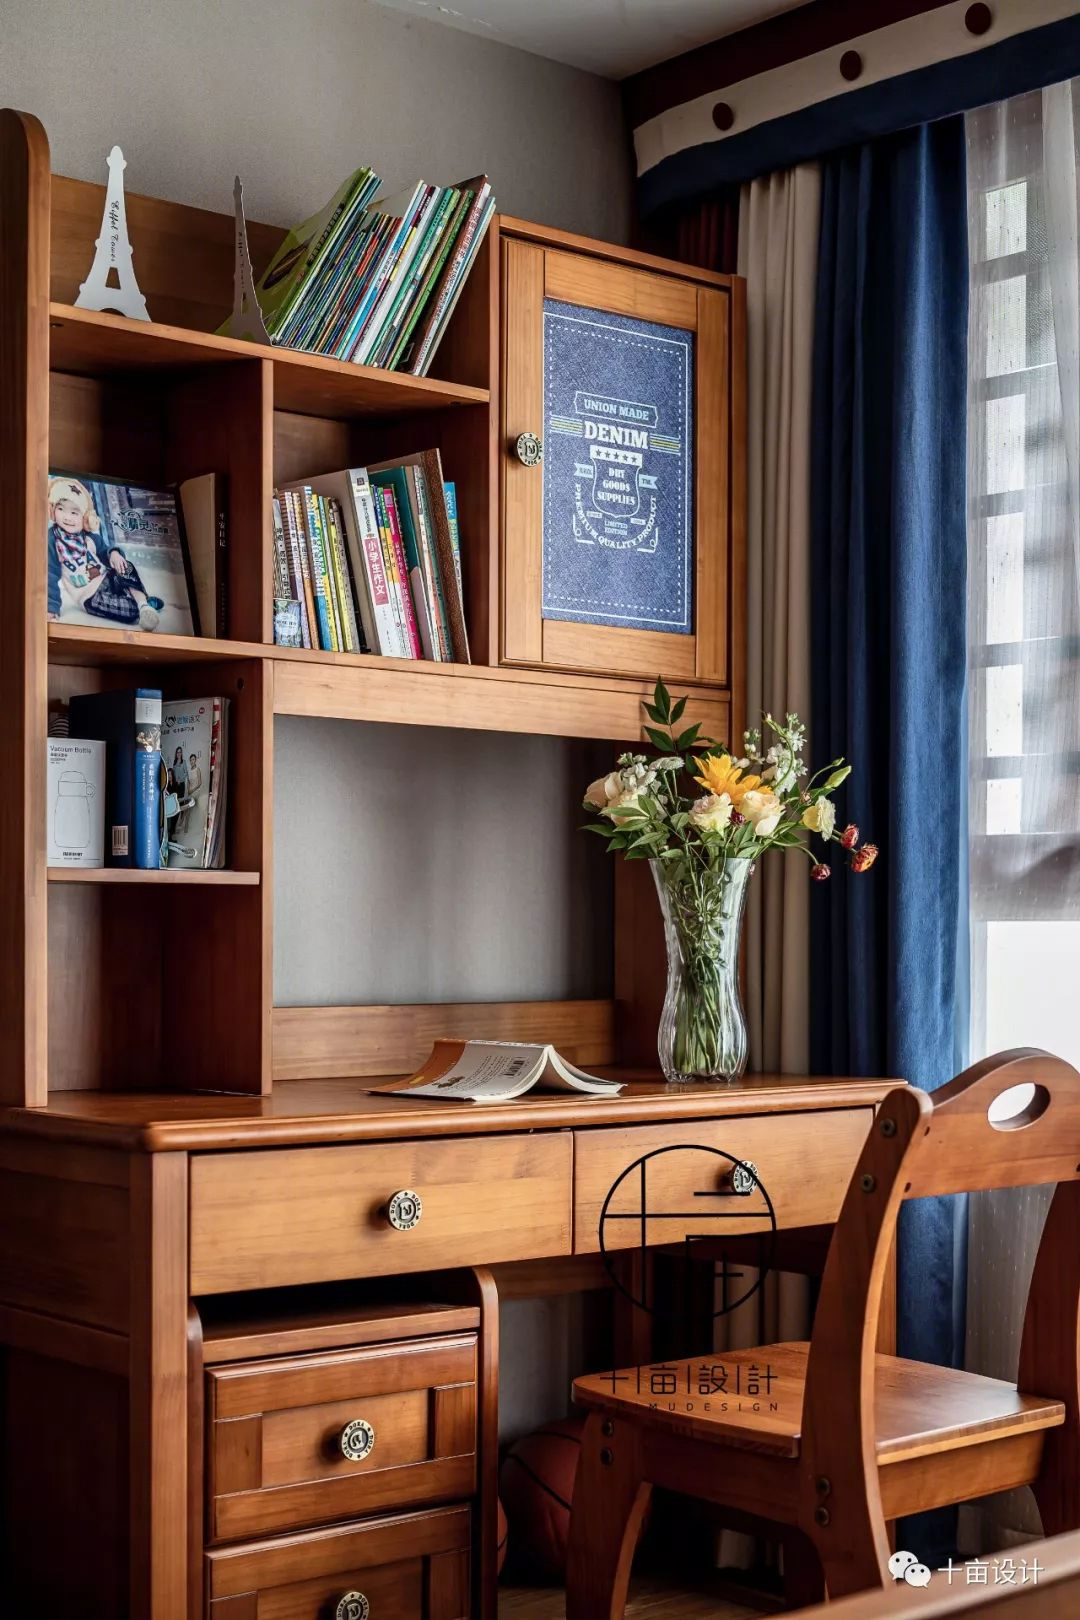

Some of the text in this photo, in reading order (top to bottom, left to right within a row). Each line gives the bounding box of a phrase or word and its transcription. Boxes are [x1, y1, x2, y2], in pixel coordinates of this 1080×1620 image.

[584, 399, 649, 421] UNION MADE
[584, 421, 649, 449] DENIM
[603, 480, 630, 492] GOODS
[597, 490, 636, 506] SUPPLIES
[575, 483, 657, 549] PREMIUM QUALITY PRODUCT
[367, 540, 386, 595] 小学生作文
[50, 745, 92, 754] Vacuum Bottle
